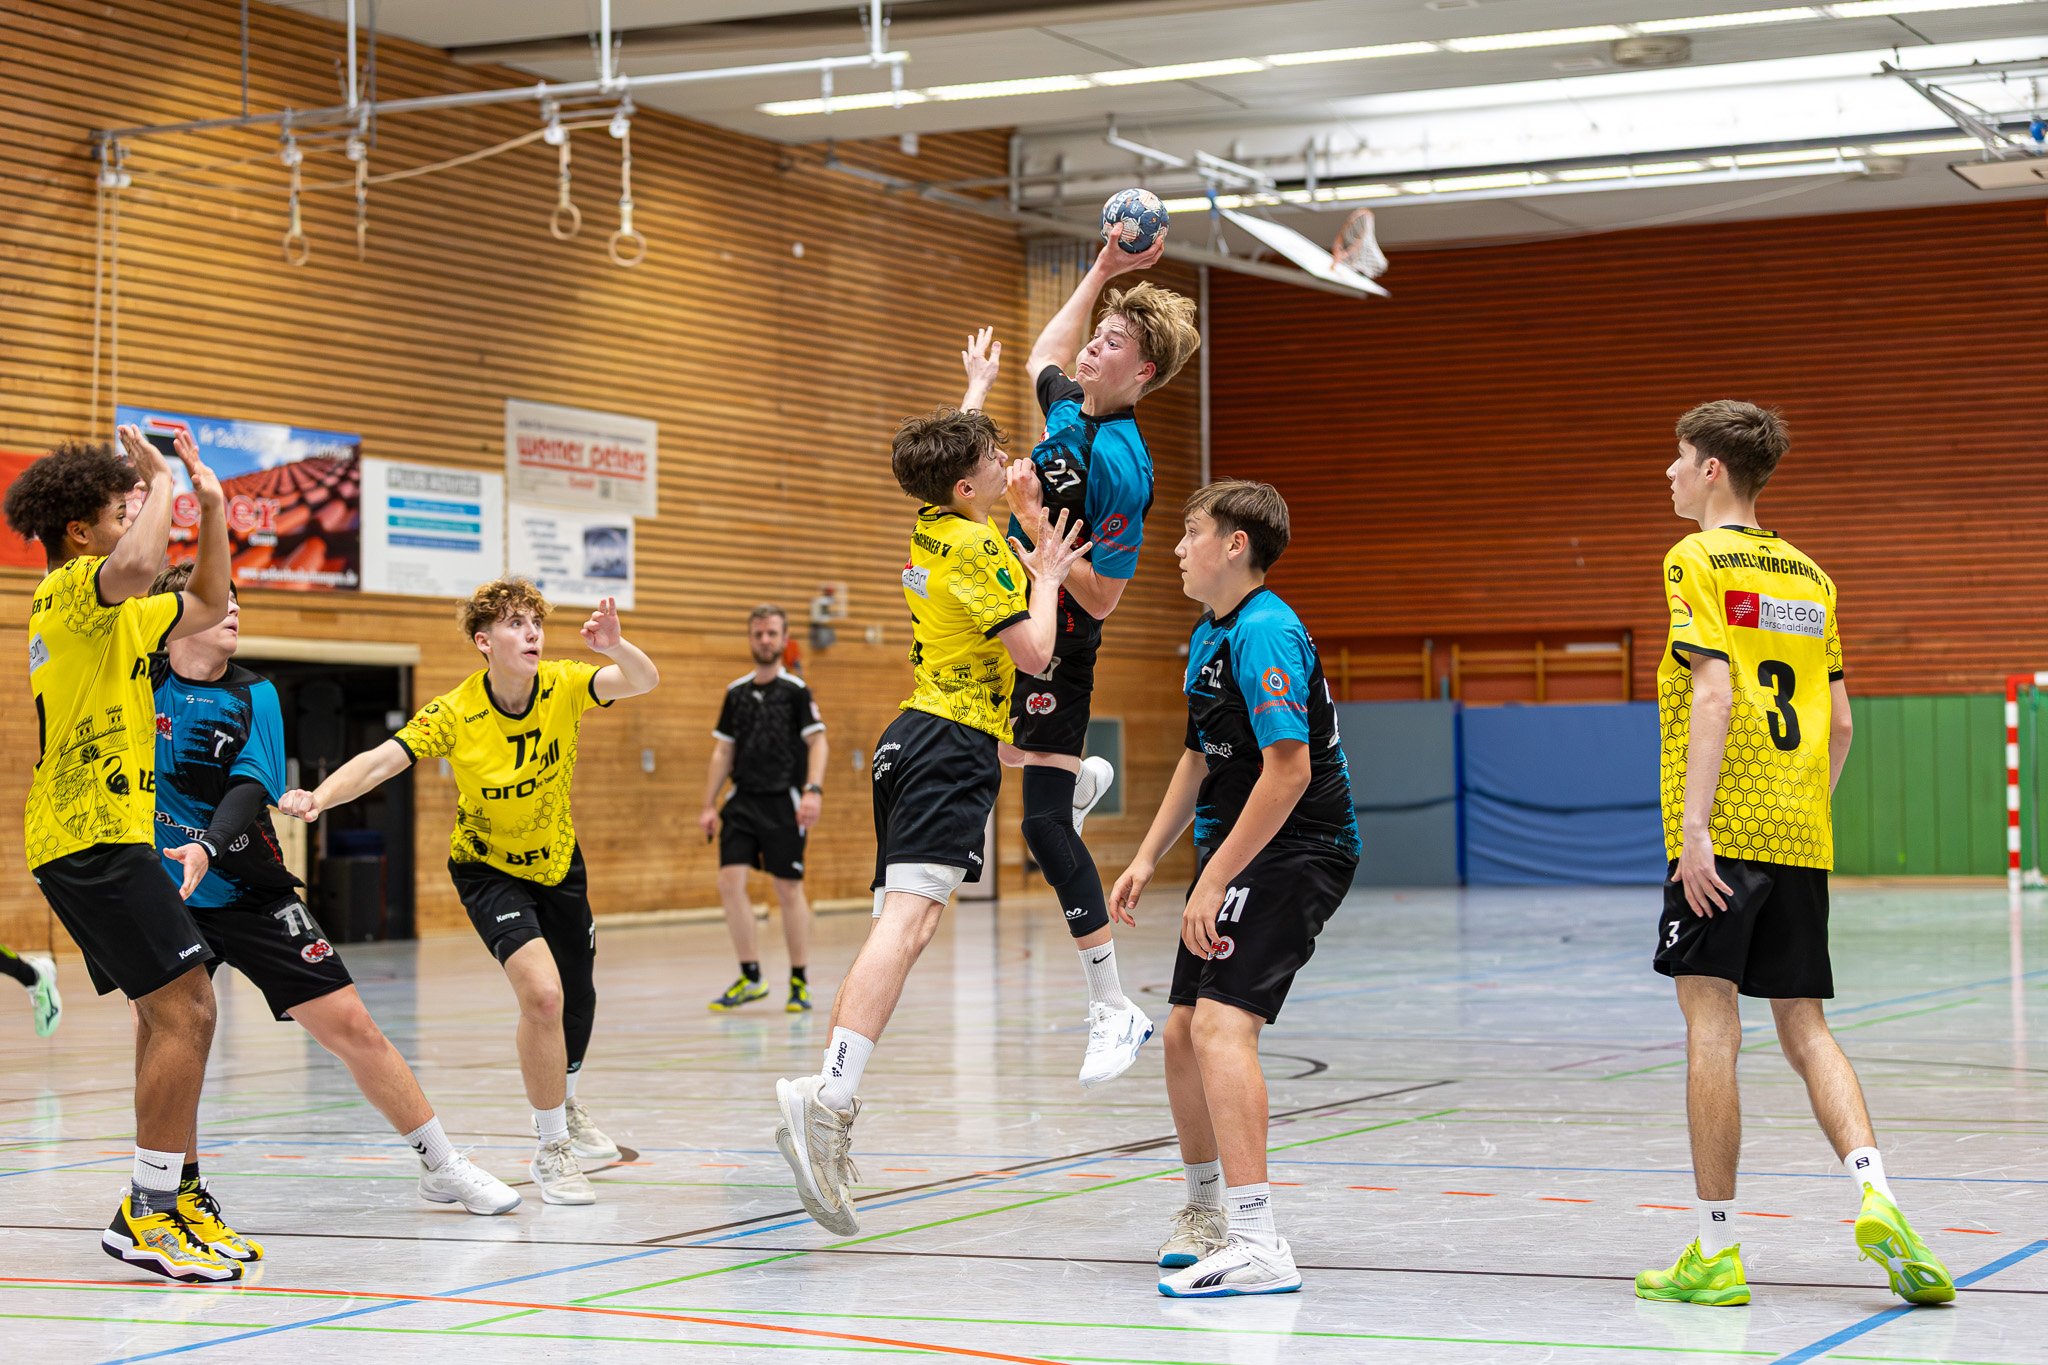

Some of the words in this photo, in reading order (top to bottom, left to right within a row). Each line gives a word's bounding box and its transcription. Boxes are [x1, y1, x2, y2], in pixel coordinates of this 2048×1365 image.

[1045, 459, 1081, 493] 27
[1761, 601, 1825, 624] meteor
[464, 709, 489, 723] Kempa
[1757, 659, 1801, 751] 3
[507, 727, 542, 771] 77
[496, 911, 521, 923] Kempa
[1218, 886, 1250, 923] 21
[1666, 920, 1681, 949] 3
[839, 1041, 848, 1069] CRAFT
